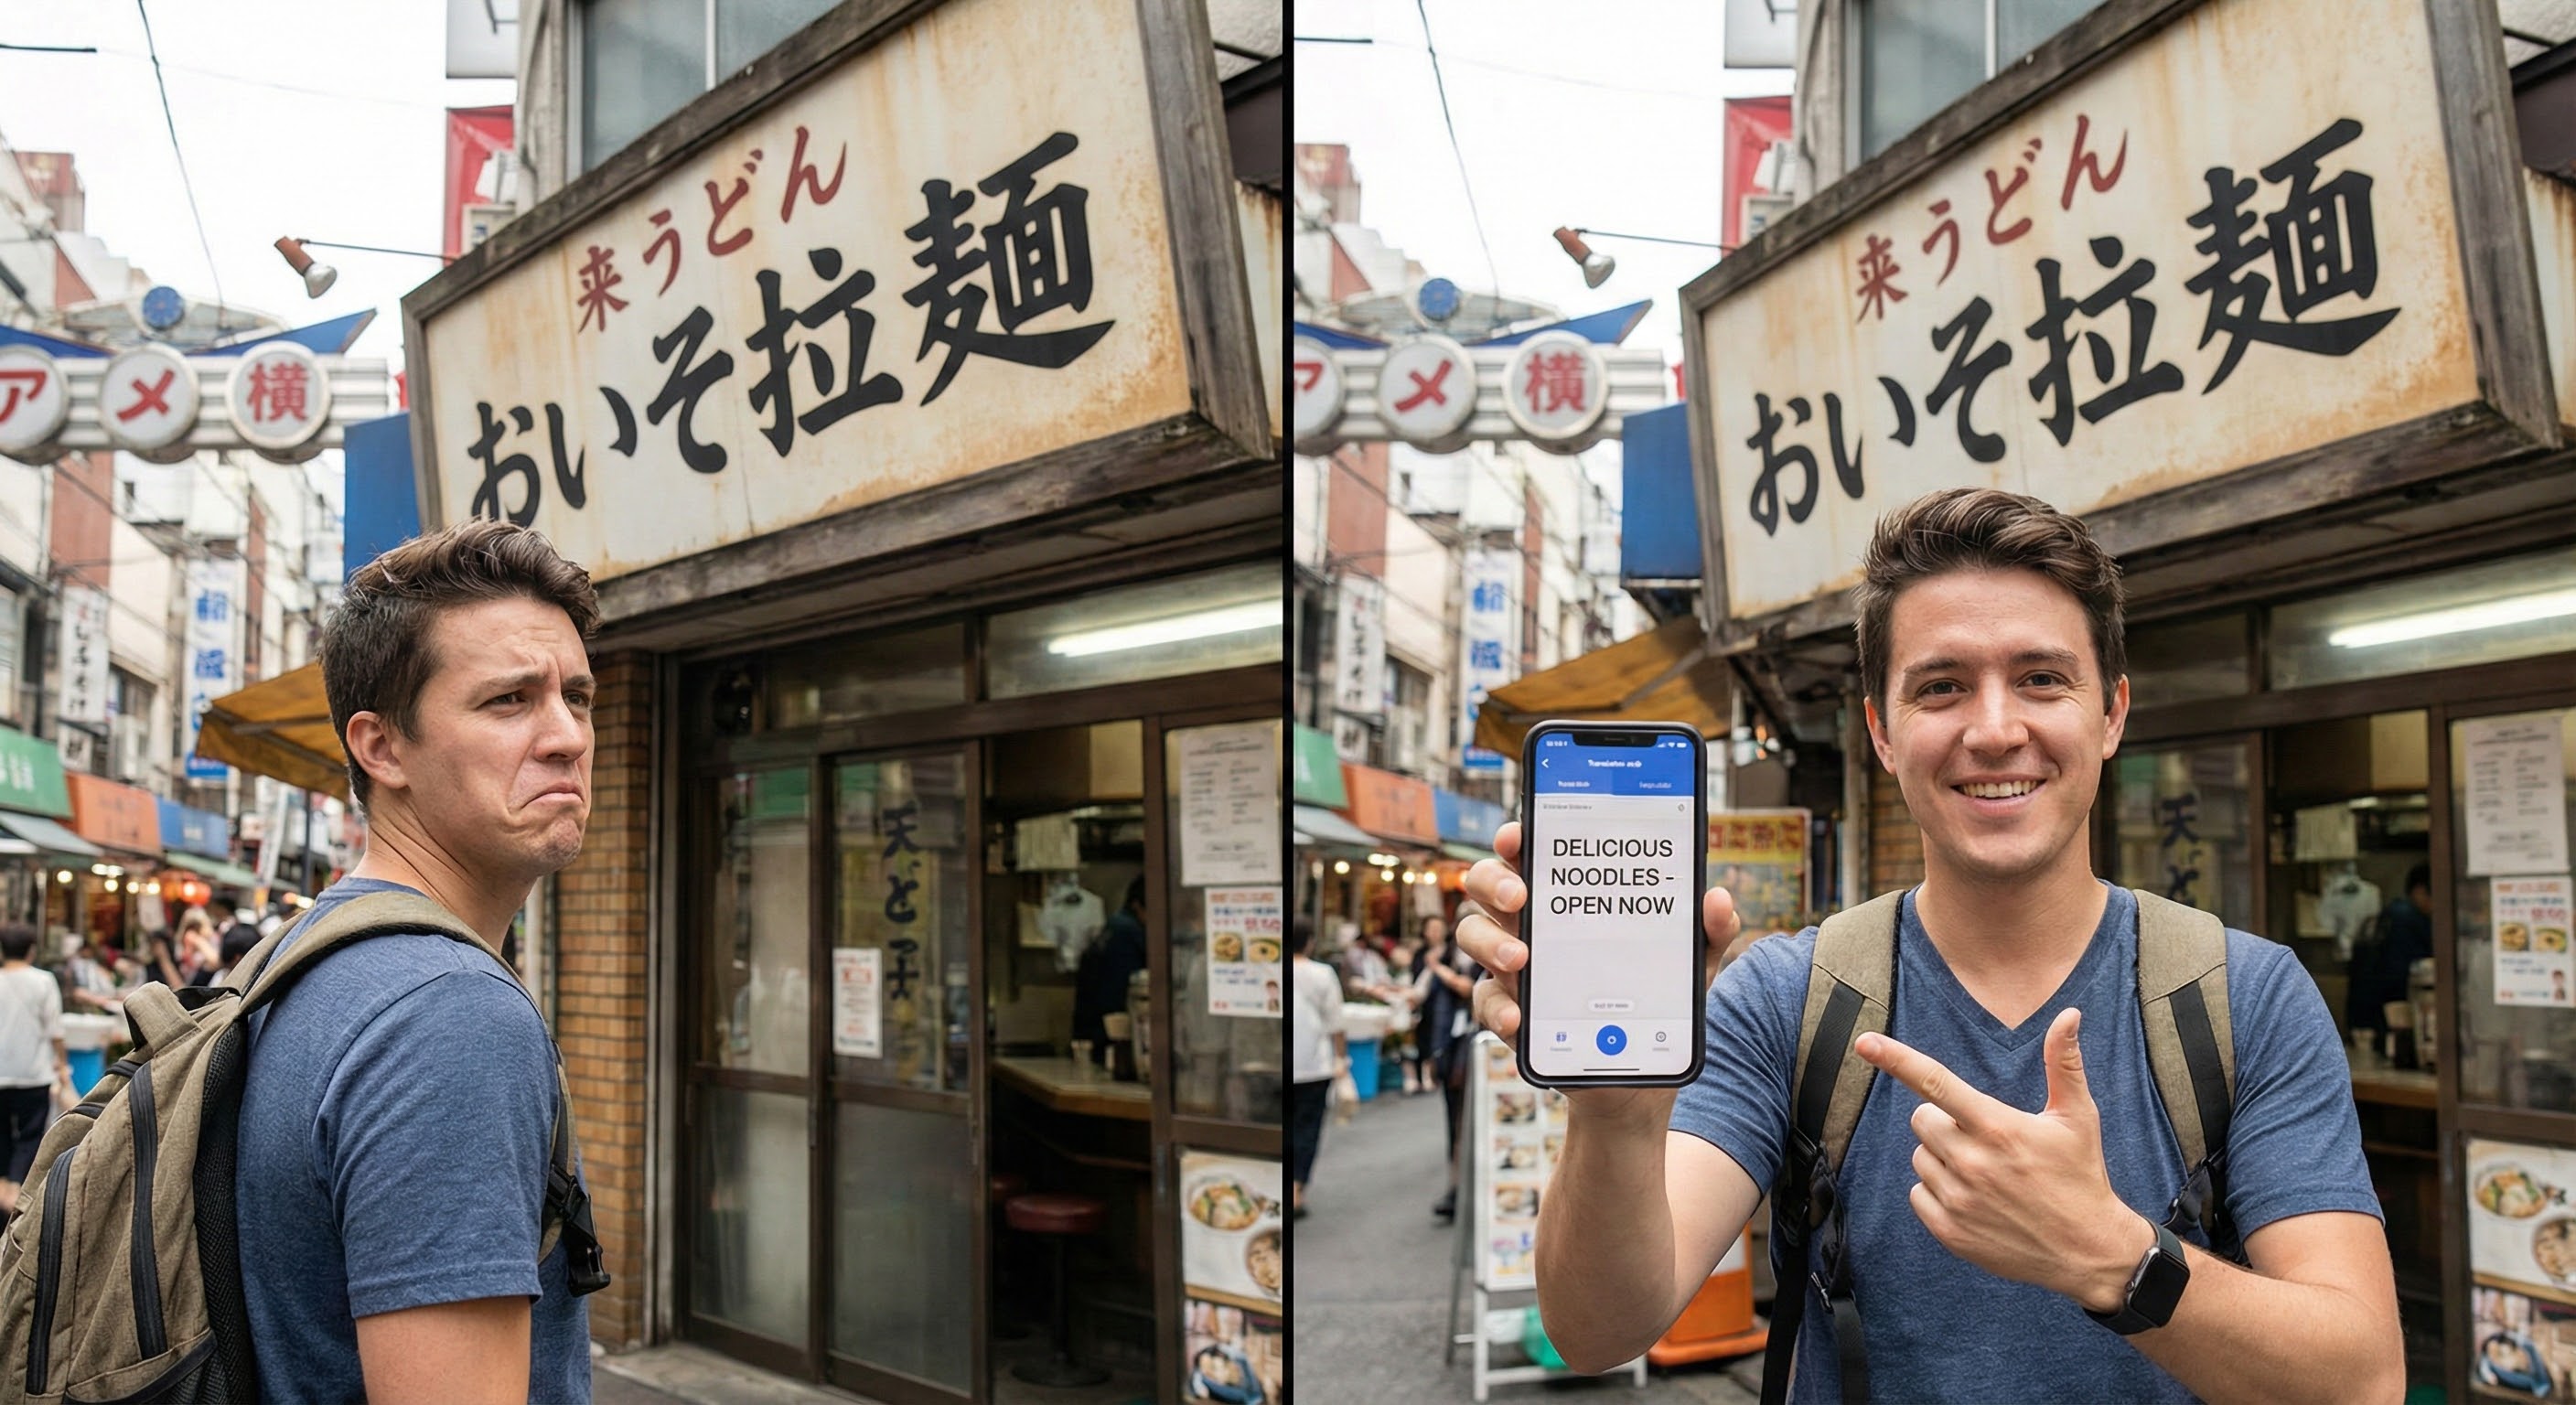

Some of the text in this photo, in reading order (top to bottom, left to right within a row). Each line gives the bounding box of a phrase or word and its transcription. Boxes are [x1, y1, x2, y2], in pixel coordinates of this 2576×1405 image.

[575, 125, 848, 334] 来うどん
[1856, 114, 2128, 323] 来うどん
[1746, 118, 2401, 537] おいそ拉麺
[0, 362, 308, 424] アメ横
[1551, 867, 1660, 886] NOODLES
[1553, 839, 1674, 858] DELICIOUS
[1551, 896, 1675, 916] OPEN NOW
